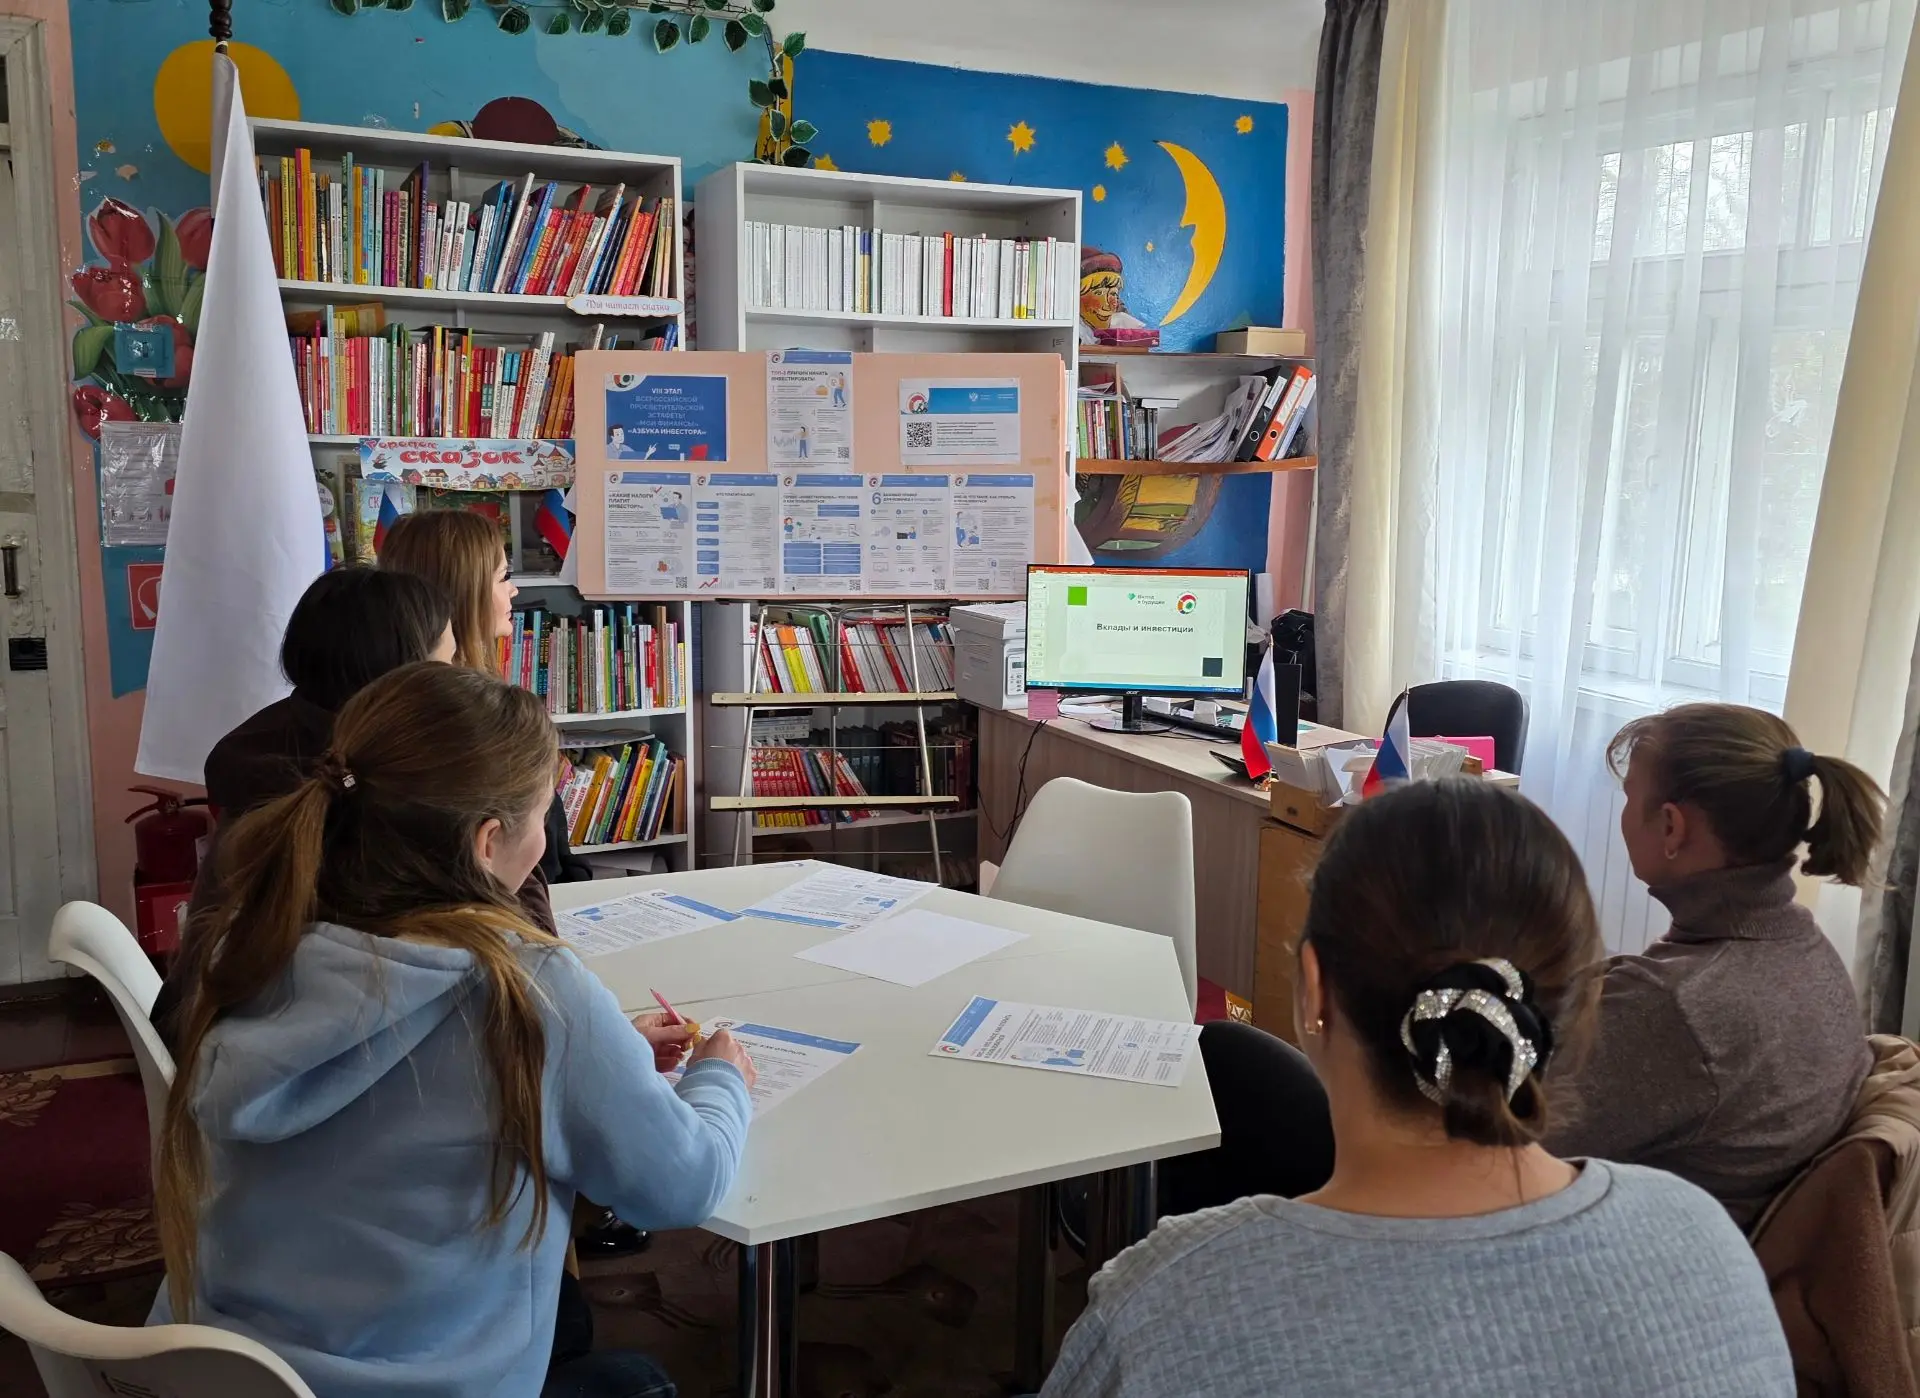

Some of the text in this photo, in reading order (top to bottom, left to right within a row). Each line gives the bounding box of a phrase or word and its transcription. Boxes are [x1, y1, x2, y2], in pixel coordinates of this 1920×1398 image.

[629, 403, 704, 411] ПРОСВЕТИТЕЛЬСКОЙ
[660, 427, 707, 435] ИНВЕСТОРА»
[364, 439, 438, 450] Городок
[872, 492, 881, 505] 6
[1096, 623, 1131, 632] Вклады
[1141, 625, 1194, 633] инвестиции
